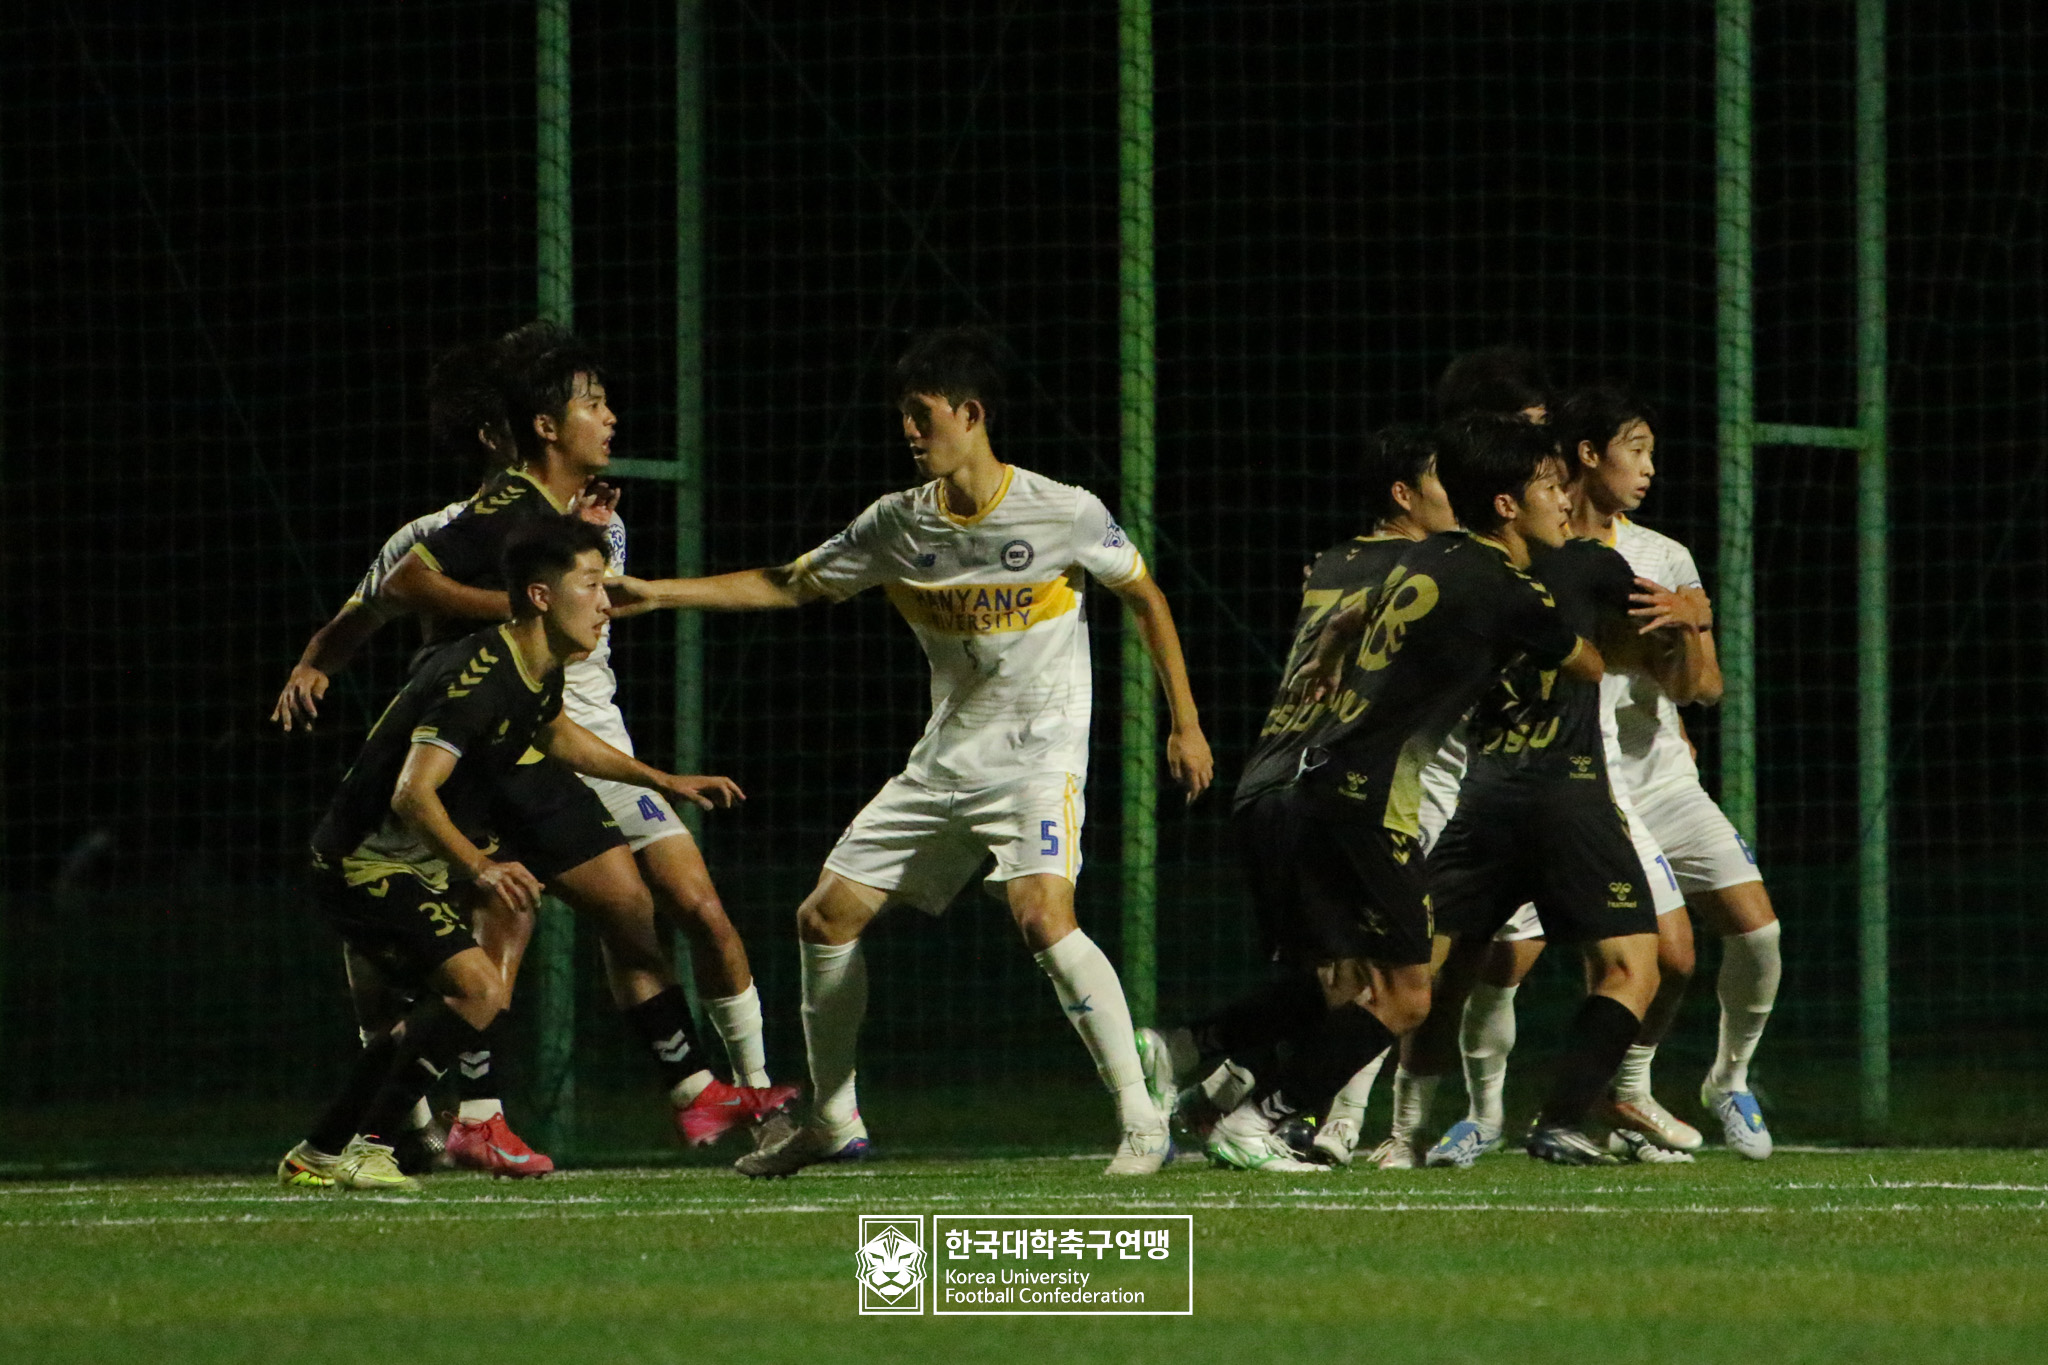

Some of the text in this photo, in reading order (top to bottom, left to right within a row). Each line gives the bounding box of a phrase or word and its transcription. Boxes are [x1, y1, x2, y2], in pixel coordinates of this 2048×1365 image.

[916, 587, 1033, 612] NYANG
[636, 794, 667, 822] 4
[1040, 820, 1059, 856] 5
